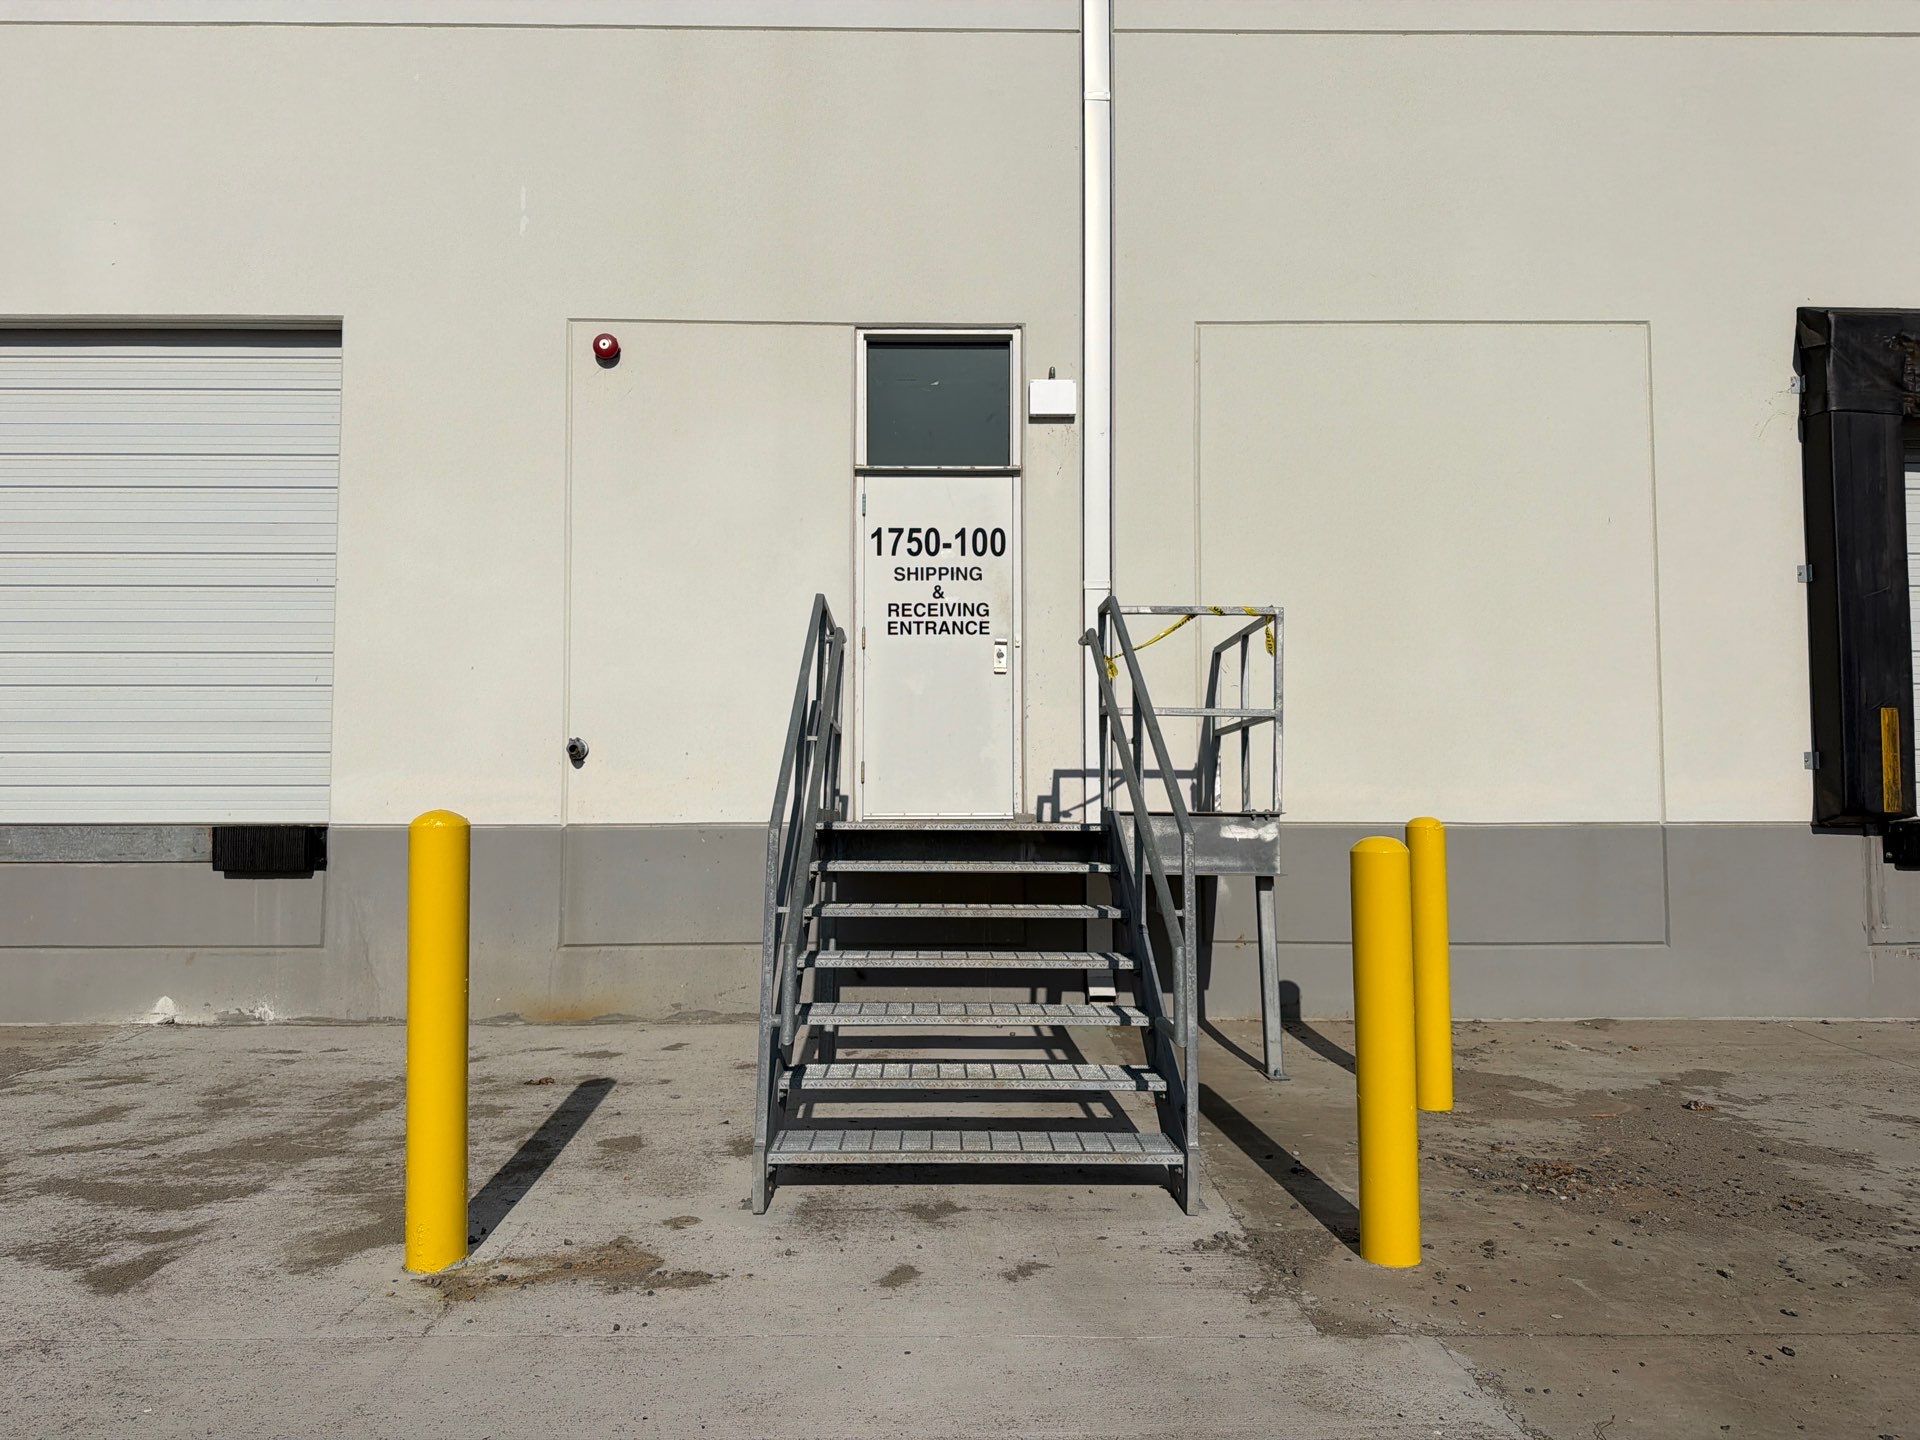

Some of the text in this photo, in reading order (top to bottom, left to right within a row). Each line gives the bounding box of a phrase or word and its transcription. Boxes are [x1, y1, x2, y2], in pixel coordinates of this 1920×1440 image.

[870, 527, 1006, 557] 1750-100
[893, 566, 983, 581] SHIPPING
[932, 584, 945, 599] &
[887, 602, 990, 618] RECEIVING
[887, 620, 991, 635] ENTRANCE
